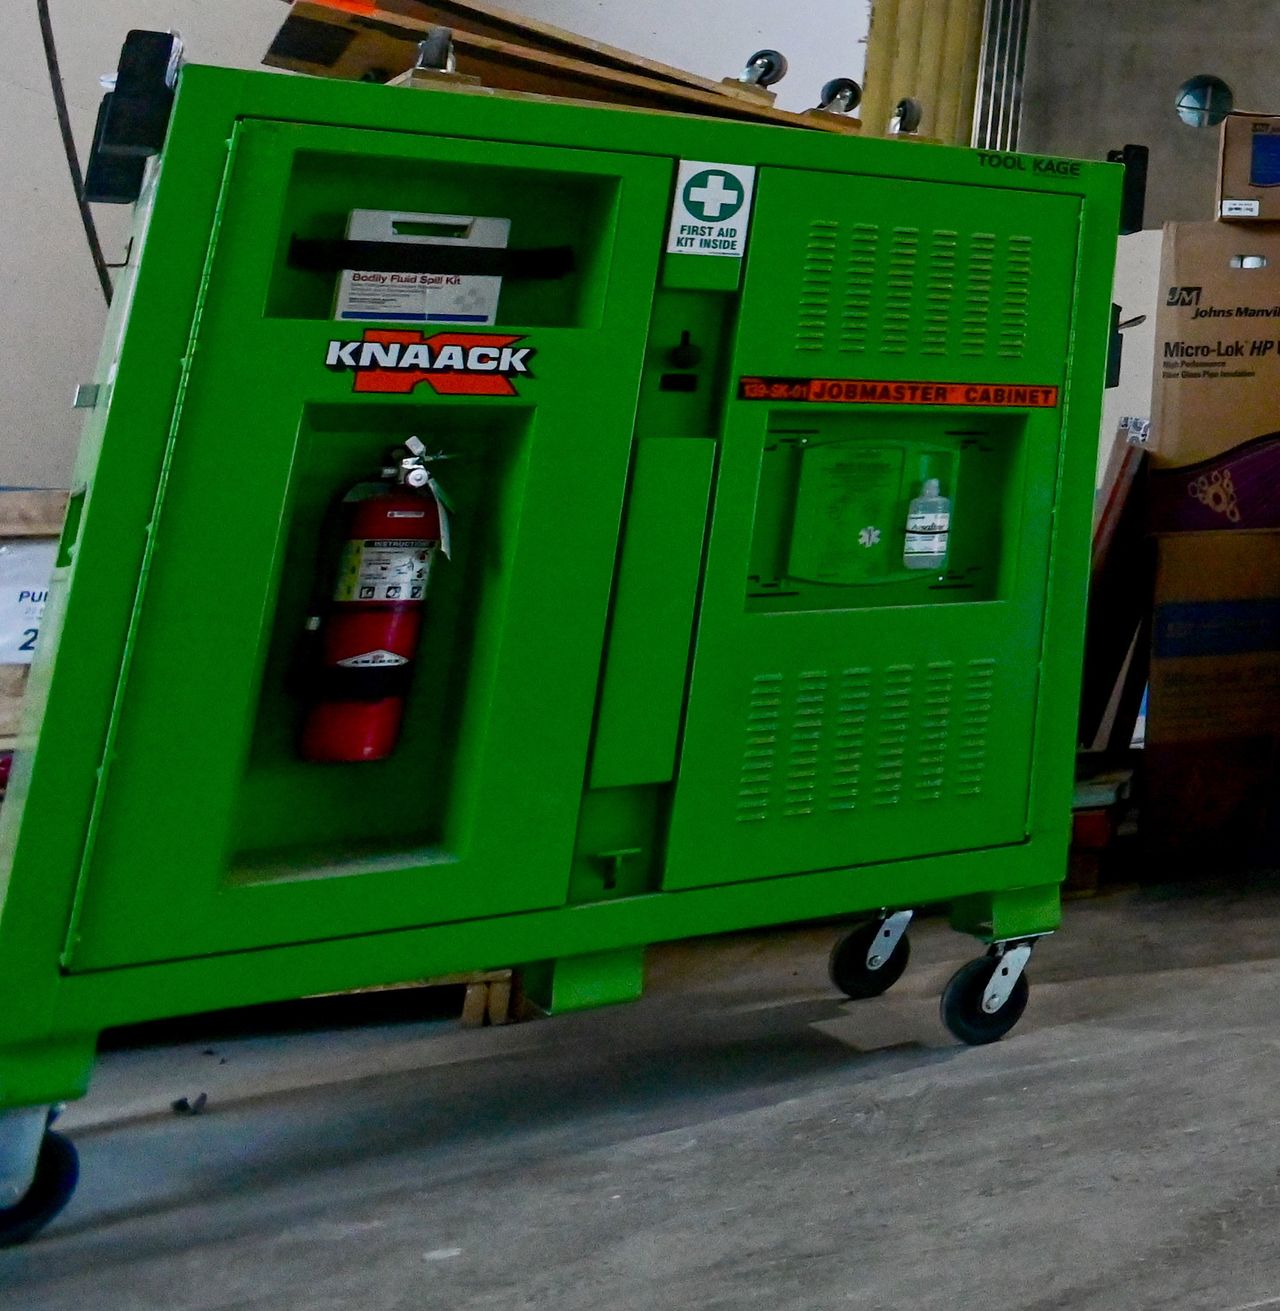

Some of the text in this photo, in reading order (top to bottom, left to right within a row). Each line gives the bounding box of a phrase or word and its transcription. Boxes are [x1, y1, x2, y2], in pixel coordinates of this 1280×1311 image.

[976, 153, 1081, 176] TOOL KAGE
[680, 225, 737, 238] FIRST AID
[676, 237, 738, 250] KIT INSIDE
[352, 273, 461, 286] Bodily Fluid Spill Kit
[1192, 306, 1233, 320] Johns
[326, 340, 531, 372] KNAACK
[1164, 341, 1244, 358] Micro-Lok
[1250, 340, 1275, 357] HP
[813, 380, 947, 402] JOBMASTER
[964, 387, 1053, 405] CABINET
